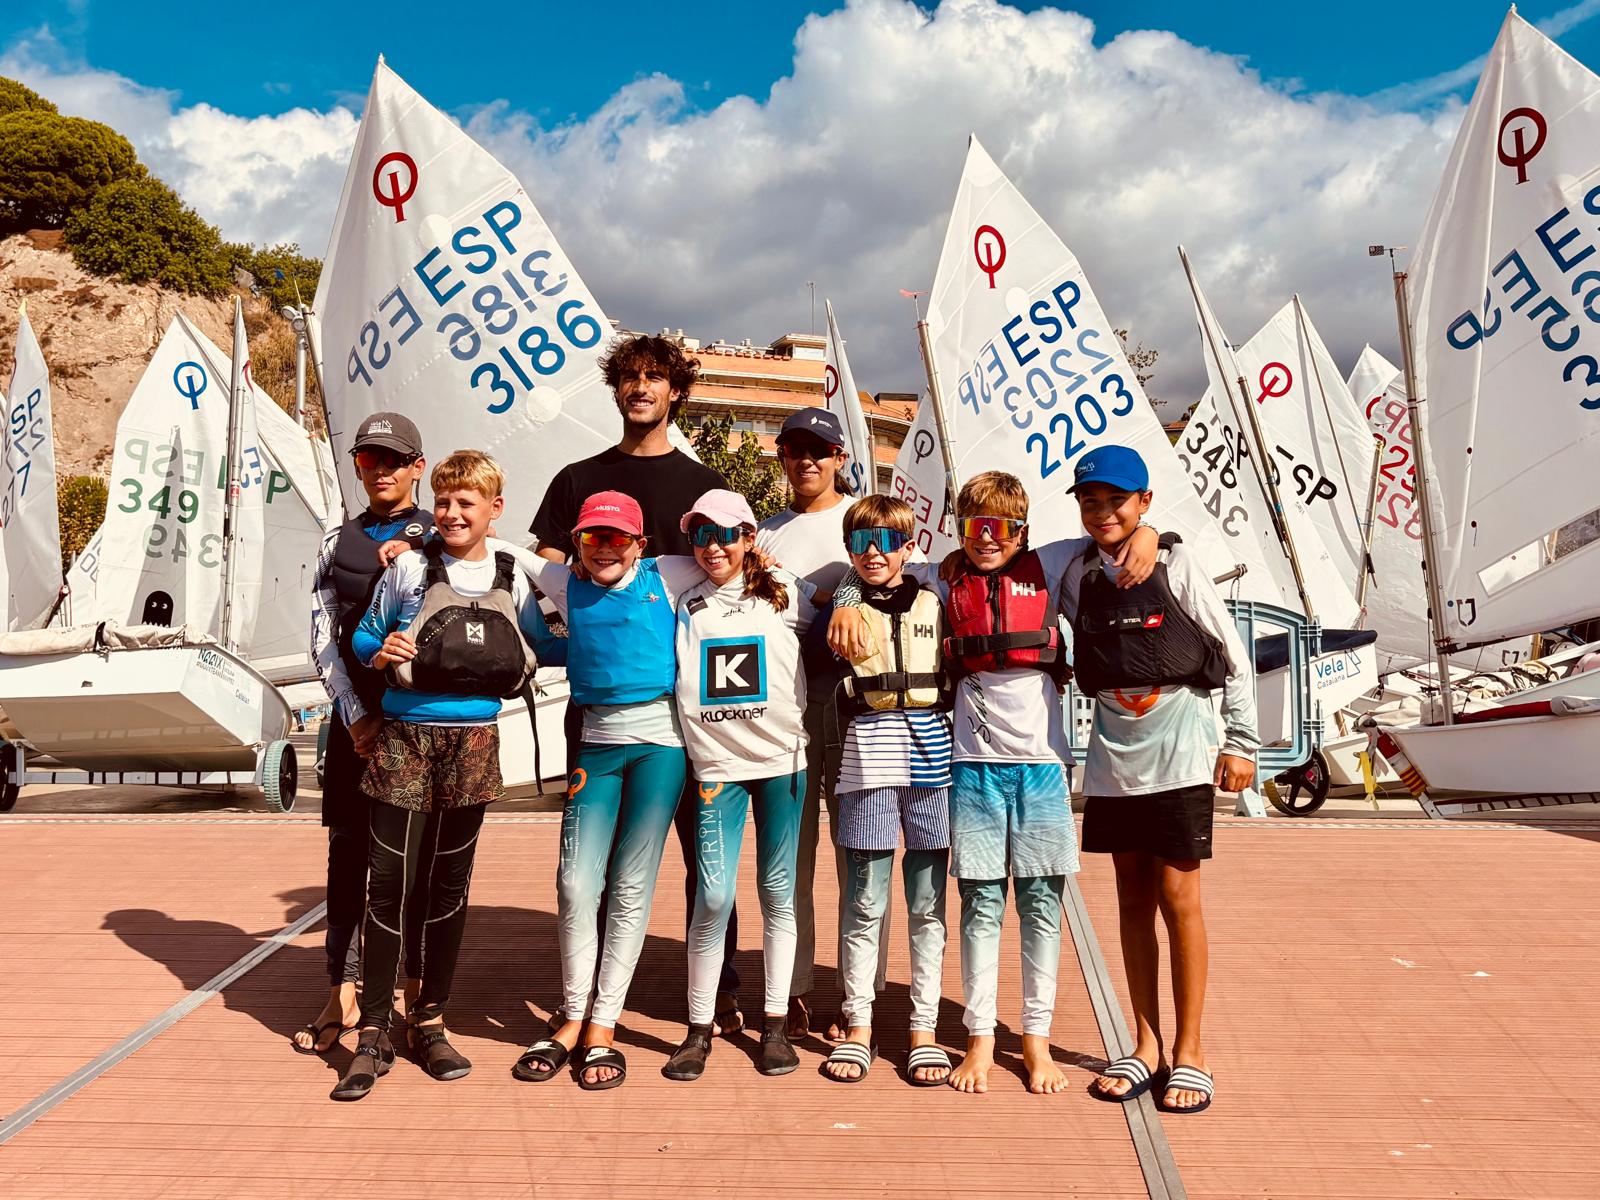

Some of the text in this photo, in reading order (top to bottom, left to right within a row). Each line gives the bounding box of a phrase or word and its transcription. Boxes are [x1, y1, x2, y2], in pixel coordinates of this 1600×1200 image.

[414, 201, 522, 307] ESP
[1002, 280, 1081, 367] ESP
[470, 300, 602, 415] 3186
[1026, 373, 1134, 479] 2203
[1223, 425, 1249, 471] SP
[1186, 422, 1238, 489] 346
[1276, 445, 1338, 506] SP
[118, 478, 199, 524] 349
[1011, 581, 1037, 597] HH
[914, 624, 934, 639] HH
[715, 653, 751, 689] K
[1315, 657, 1344, 678] Vela
